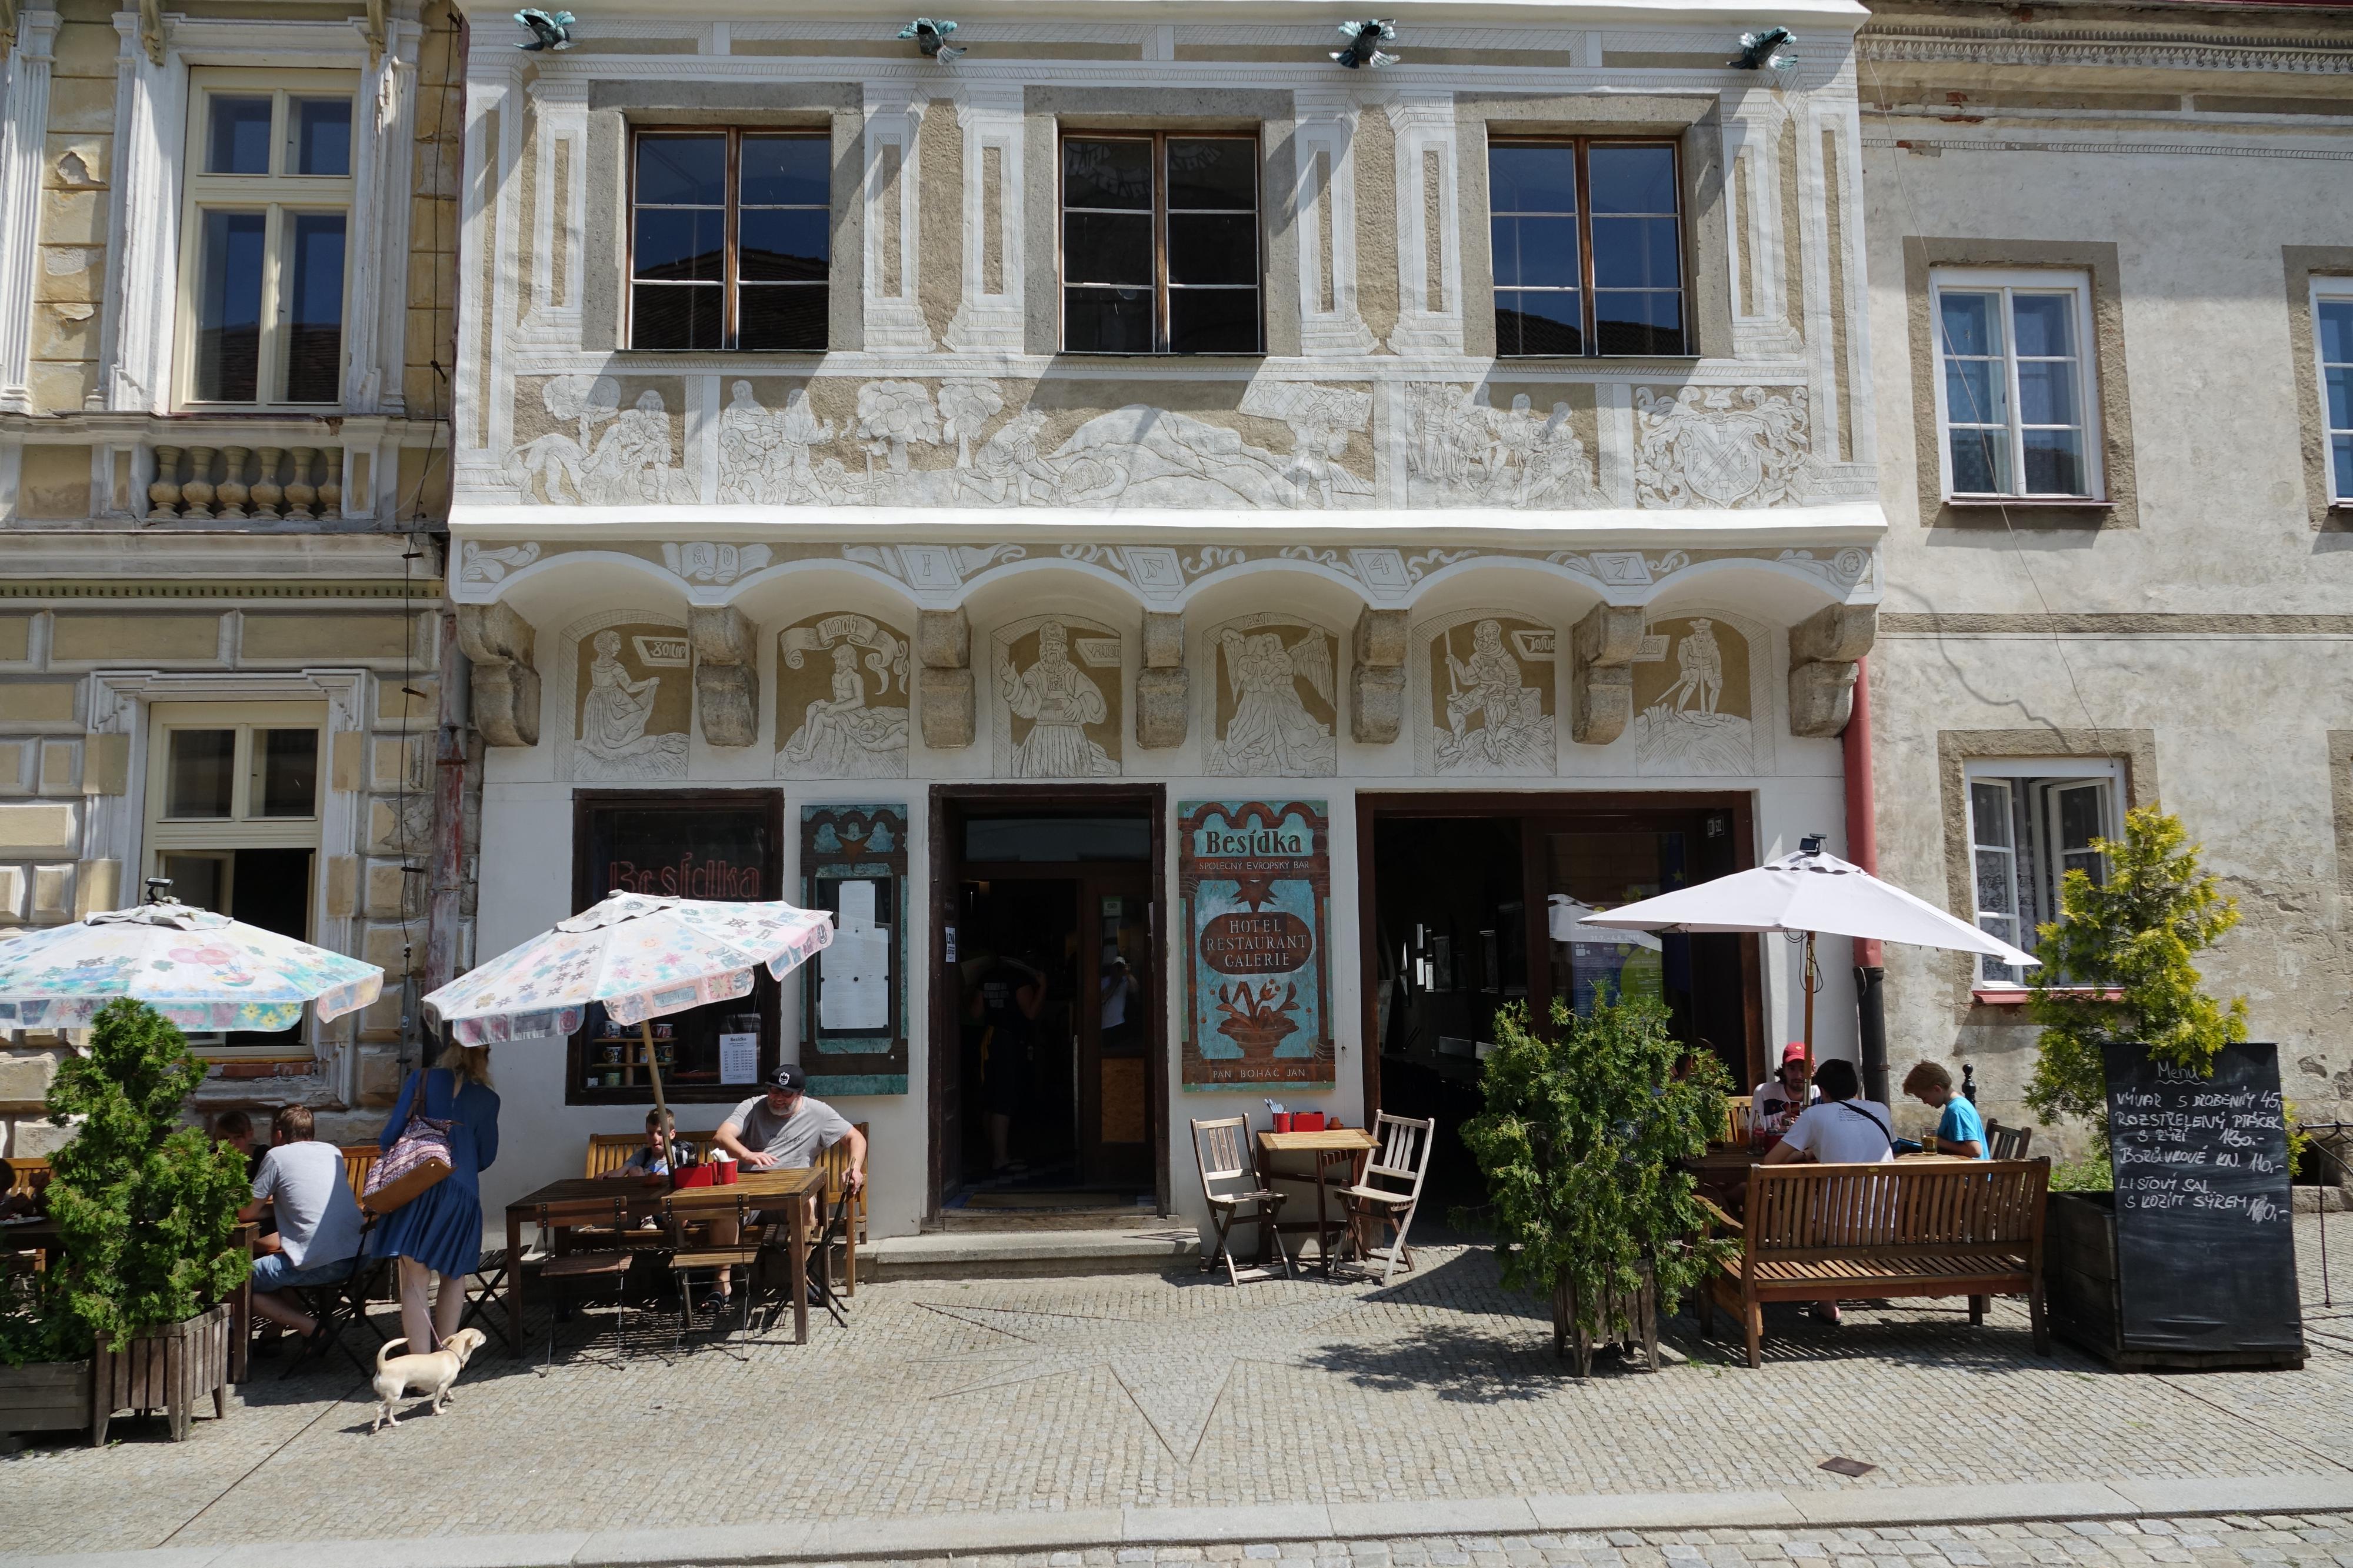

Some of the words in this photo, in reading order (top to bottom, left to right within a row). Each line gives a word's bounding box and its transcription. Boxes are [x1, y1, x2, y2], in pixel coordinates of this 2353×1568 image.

[1206, 829, 1302, 856] Besídka
[1294, 860, 1309, 869] BAR
[609, 852, 760, 899] Besídka
[1229, 919, 1281, 933] HOTEL
[1207, 935, 1307, 951] RESTAURANT
[1225, 952, 1289, 968] GALERIE
[1213, 1070, 1232, 1079] PAN
[1241, 1067, 1280, 1078] BOHÁČ
[1287, 1068, 1305, 1077] JAN
[2157, 1061, 2200, 1080] Menu
[2117, 1086, 2161, 1107] VÝVAR
[2177, 1095, 2188, 1107] S
[2137, 1129, 2149, 1143] S
[2119, 1172, 2178, 1191] LISTOVÝ
[2125, 1195, 2137, 1209] S
